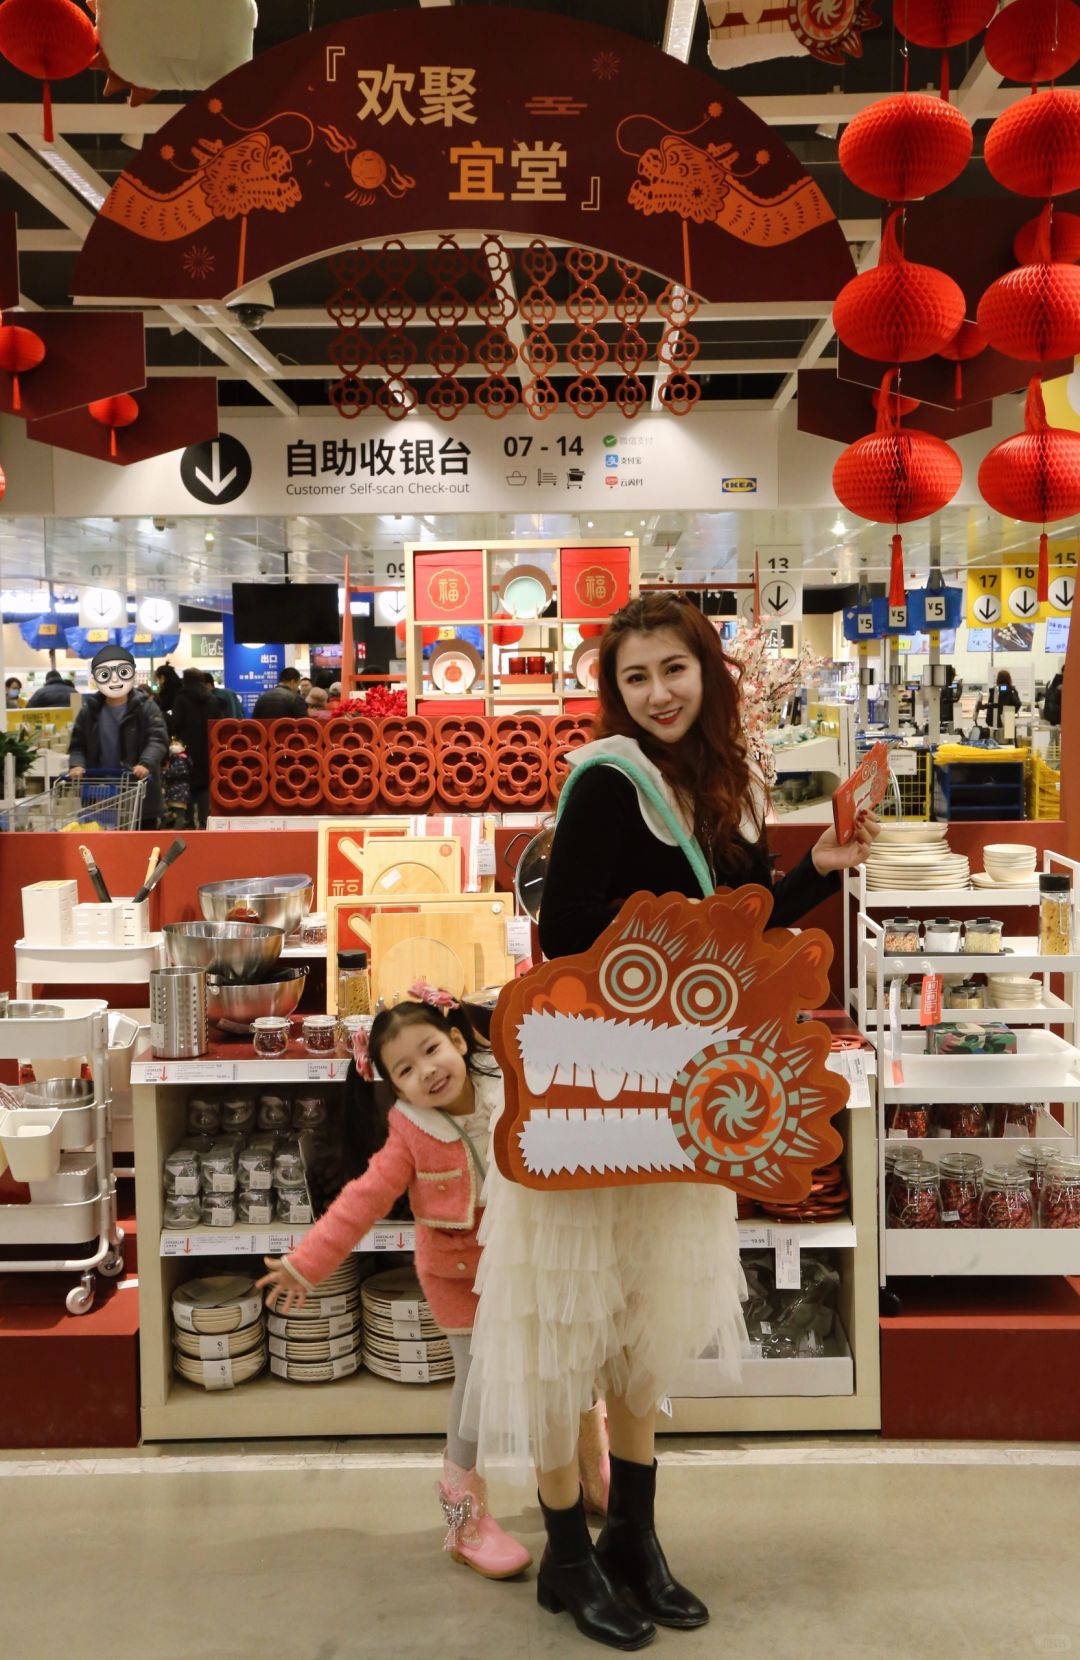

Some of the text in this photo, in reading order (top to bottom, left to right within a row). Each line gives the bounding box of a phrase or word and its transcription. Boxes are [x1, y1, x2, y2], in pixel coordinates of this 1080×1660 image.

[503, 434, 533, 458] 07
[556, 434, 584, 458] 14
[286, 437, 471, 477] 自助收银台
[621, 457, 642, 465] 支付宝
[286, 482, 470, 496] Customer Self-scan Check-out
[724, 481, 755, 489] IKEA
[768, 557, 789, 573] 13
[1055, 552, 1076, 569] 15
[91, 564, 113, 577] 07
[1015, 566, 1035, 579] 16
[585, 575, 607, 600] 福
[979, 575, 997, 589] 17
[438, 578, 459, 604] 福
[928, 602, 943, 616] ¥5
[891, 610, 905, 623] ¥5
[260, 654, 278, 664] 出口
